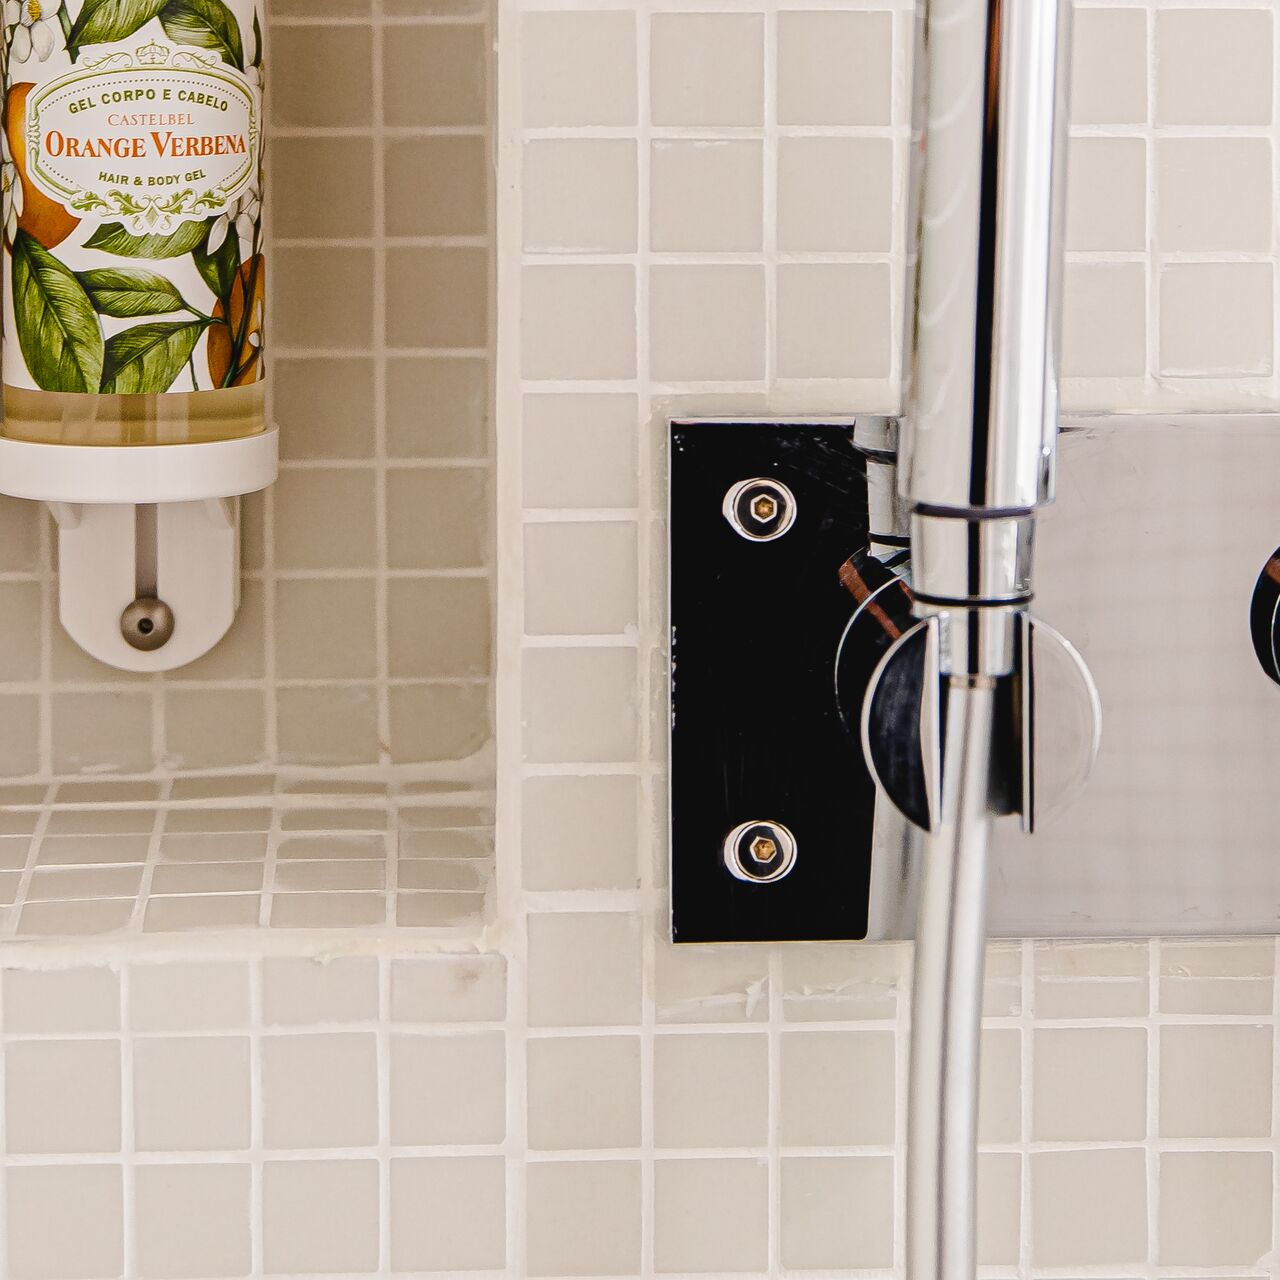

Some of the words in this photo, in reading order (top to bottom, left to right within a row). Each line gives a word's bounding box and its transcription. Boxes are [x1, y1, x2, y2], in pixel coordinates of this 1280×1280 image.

[69, 97, 97, 114] GEL
[101, 88, 156, 105] CORPO
[163, 89, 172, 100] E
[177, 89, 228, 112] CABELO
[107, 113, 195, 126] CASTELBEL
[45, 130, 146, 158] ORANGE
[150, 131, 246, 158] VERBENA
[98, 171, 128, 186] HAIR
[133, 175, 143, 186] &
[147, 174, 180, 186] BODY
[184, 169, 207, 182] GEL
